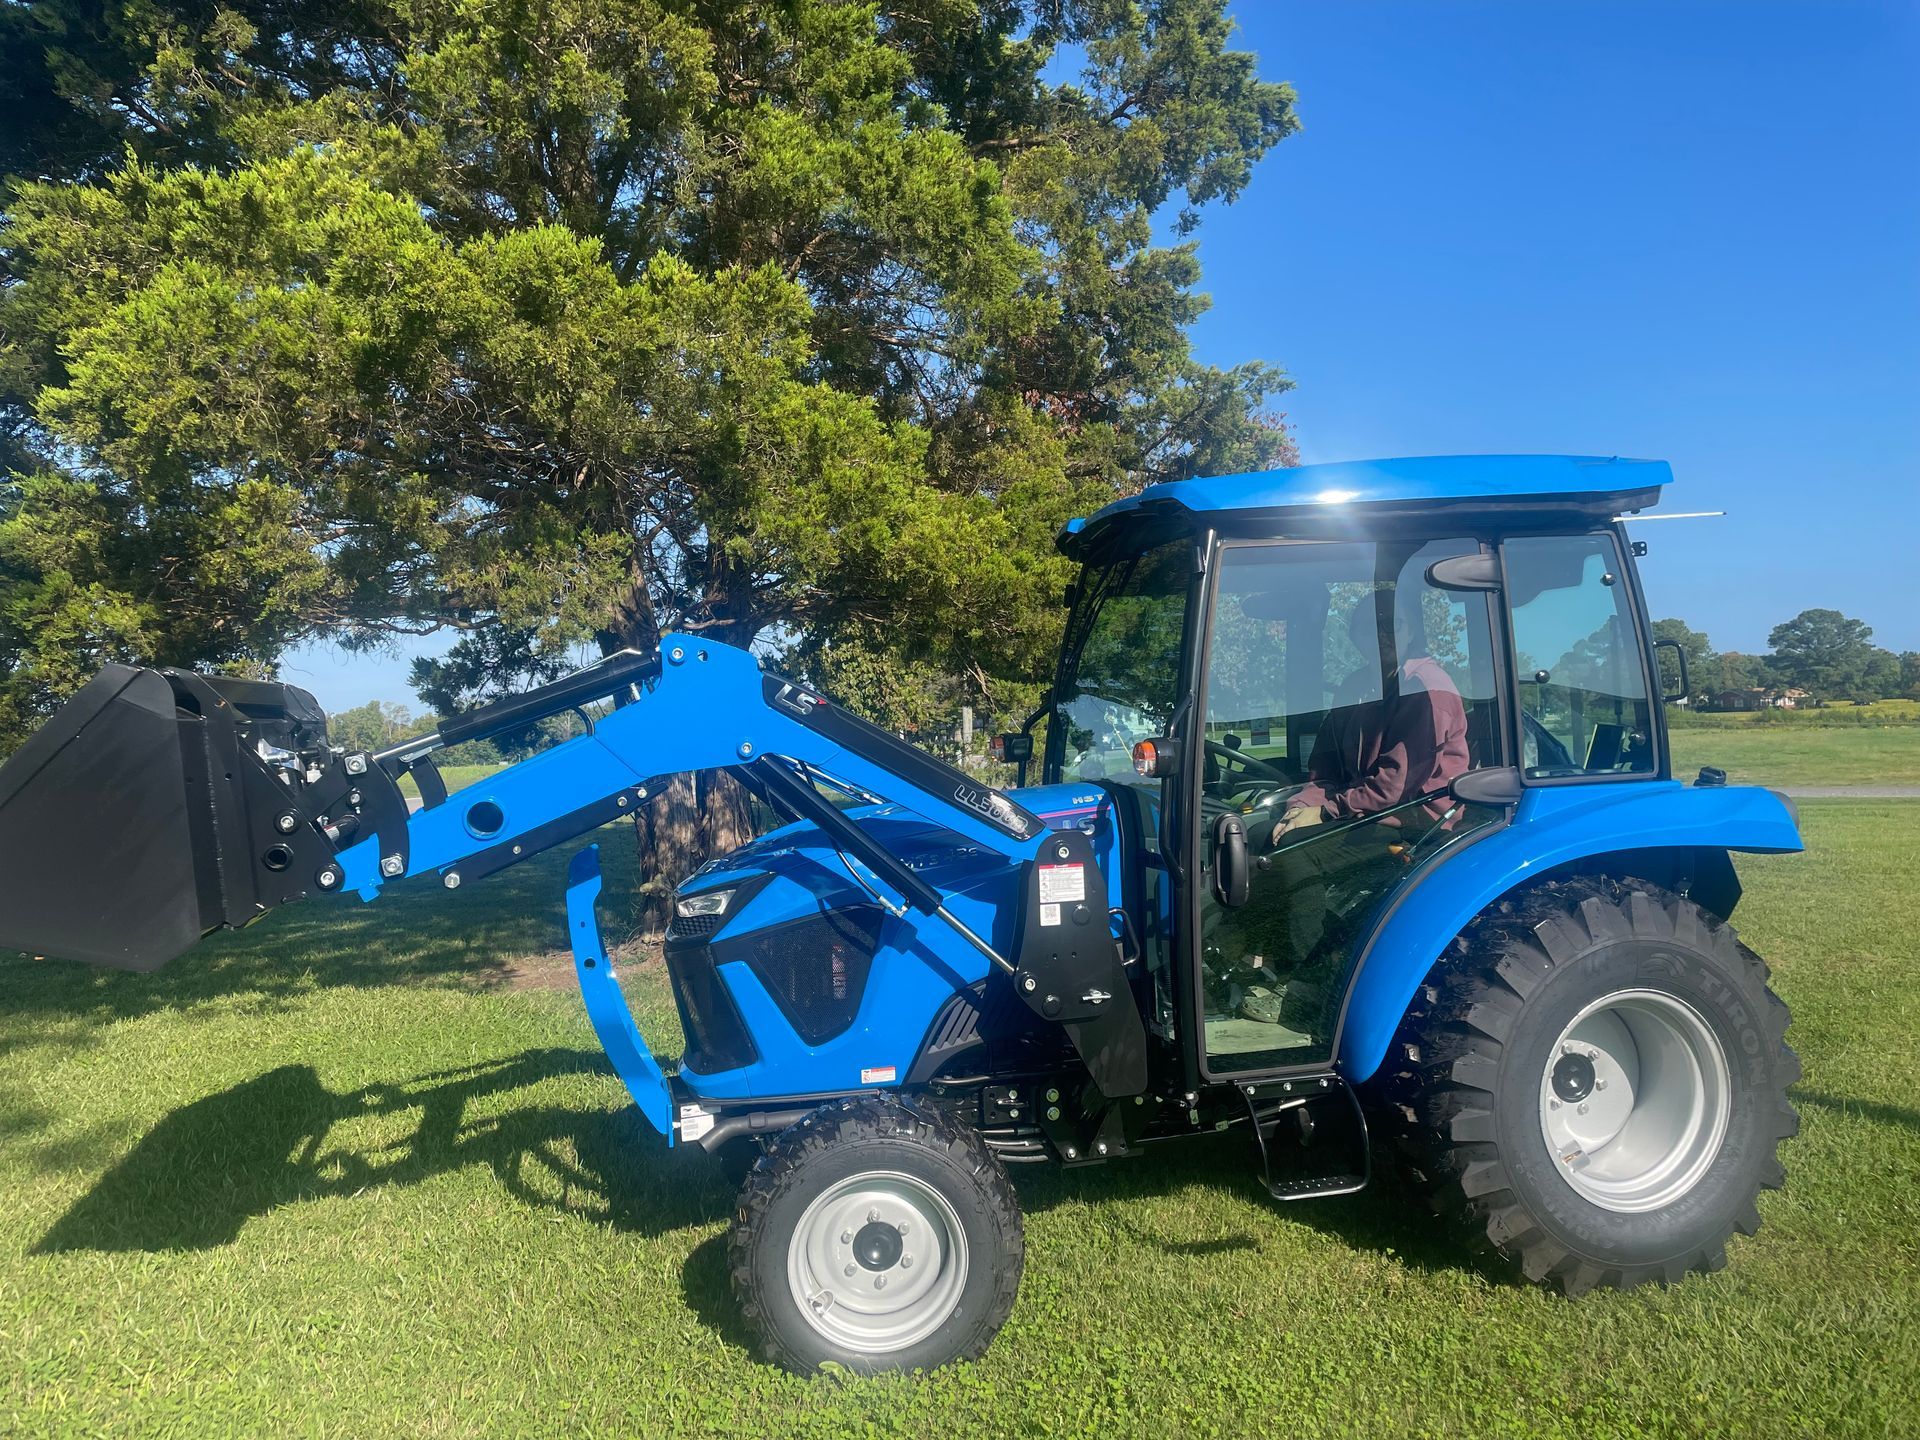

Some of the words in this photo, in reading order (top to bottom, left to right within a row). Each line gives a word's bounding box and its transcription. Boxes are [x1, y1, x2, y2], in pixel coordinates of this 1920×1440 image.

[774, 683, 819, 716] LS
[1072, 793, 1105, 805] HST
[1699, 967, 1767, 1086] TIRON
